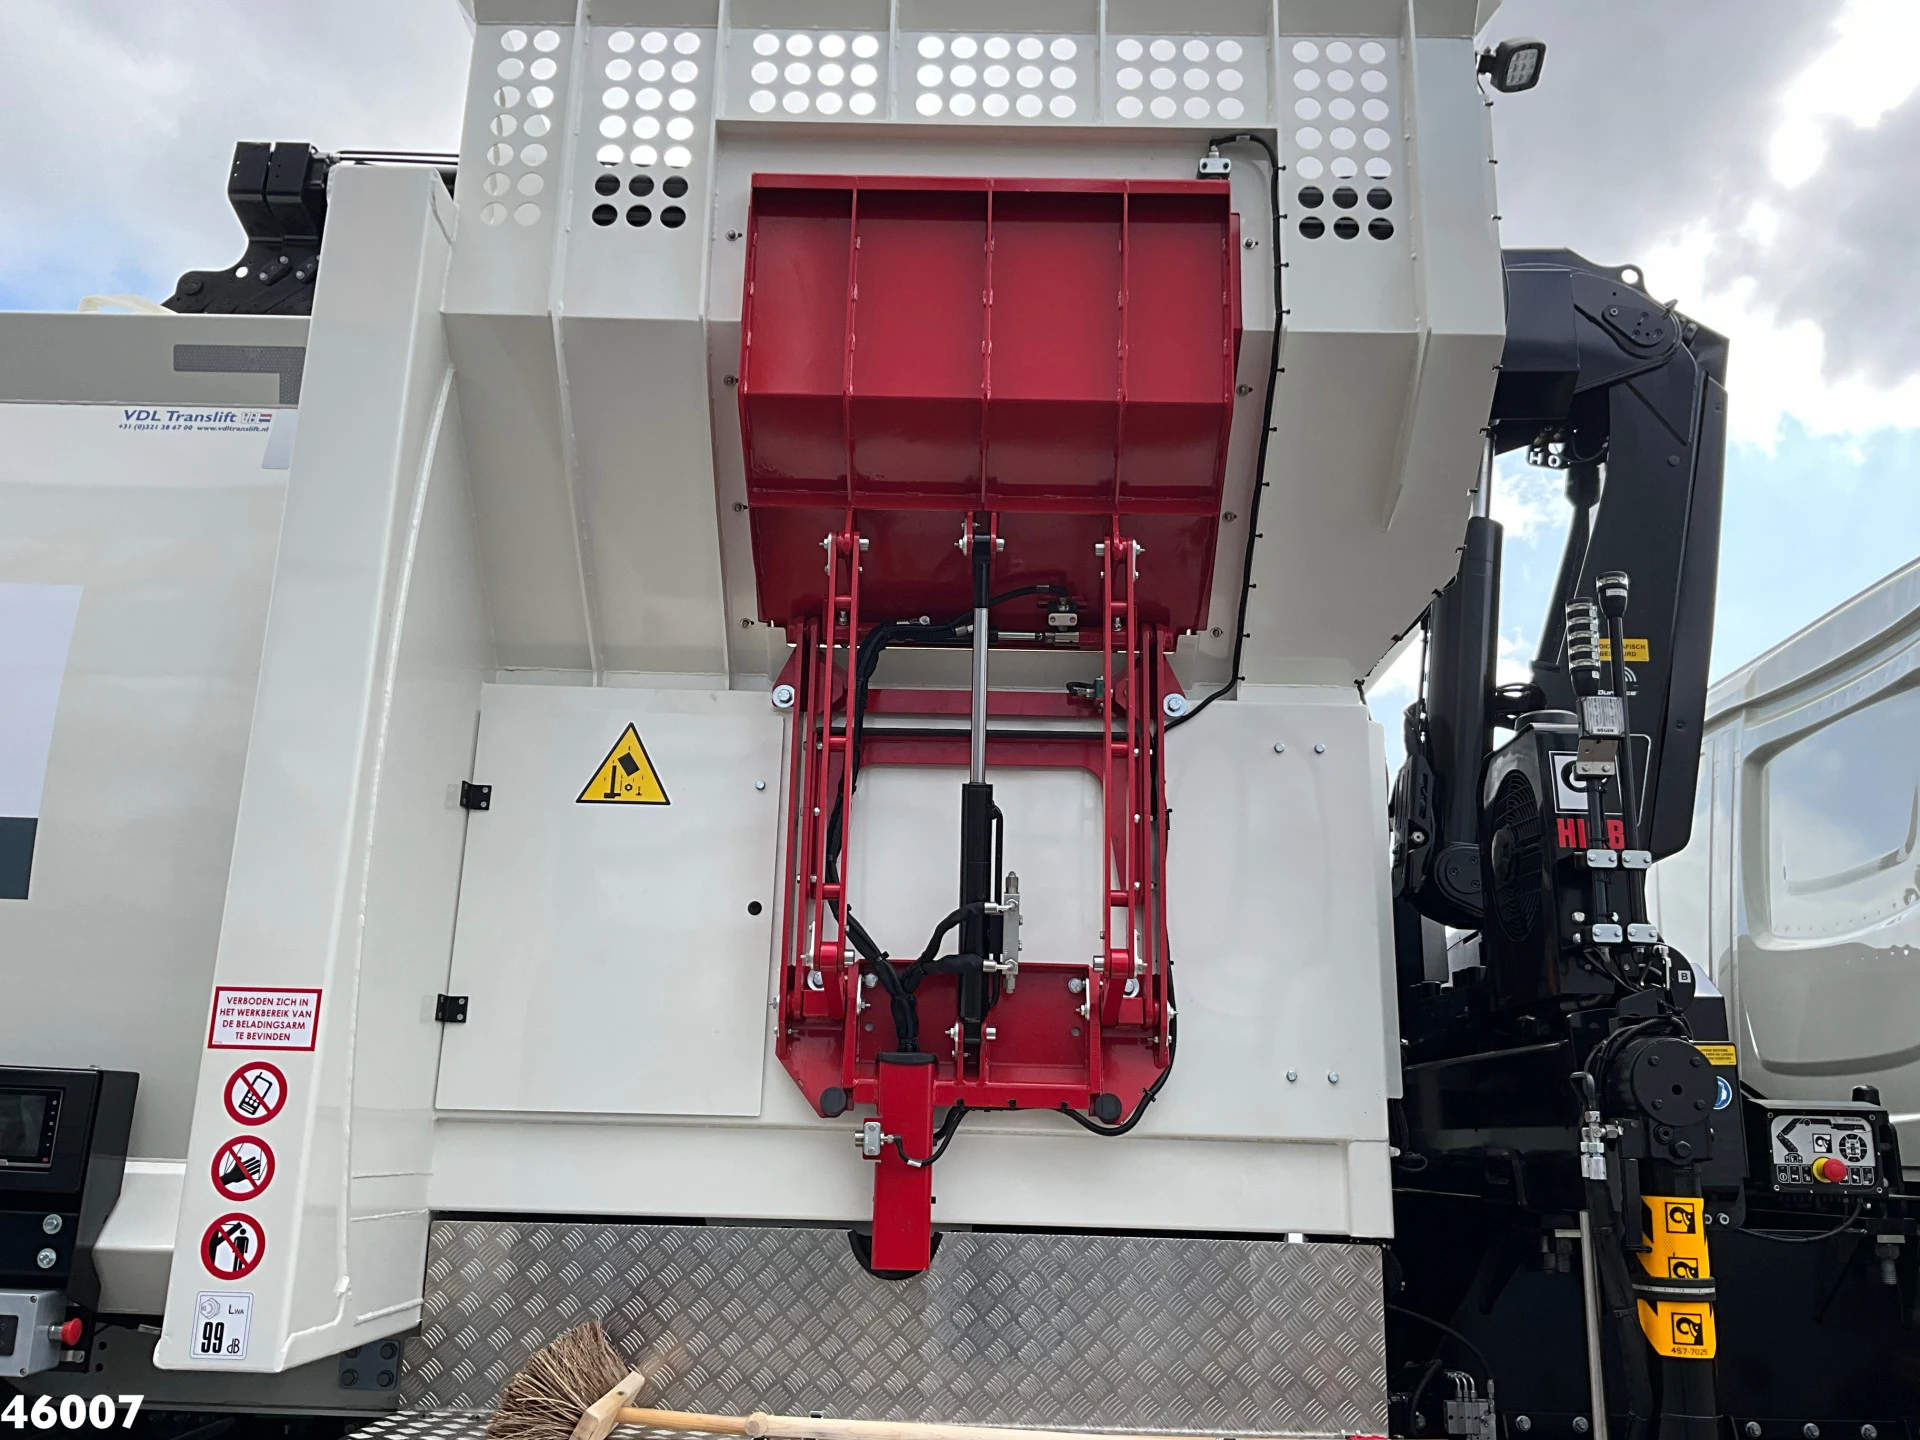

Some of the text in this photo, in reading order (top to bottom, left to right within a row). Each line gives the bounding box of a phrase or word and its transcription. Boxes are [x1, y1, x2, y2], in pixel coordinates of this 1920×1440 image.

[124, 410, 161, 421] VDL
[166, 410, 237, 423] Translift
[1556, 818, 1625, 849] HIB
[1681, 972, 1688, 980] B
[226, 996, 309, 1007] VERBODEN ZICH IN
[219, 1008, 312, 1018] HET WERKBEREIK VAN
[222, 1020, 306, 1030] DE BELADINGSARM
[235, 1032, 291, 1041] TE BEVINDEN
[201, 1321, 240, 1354] 99 dB
[1671, 1347, 1708, 1356] 457-7025
